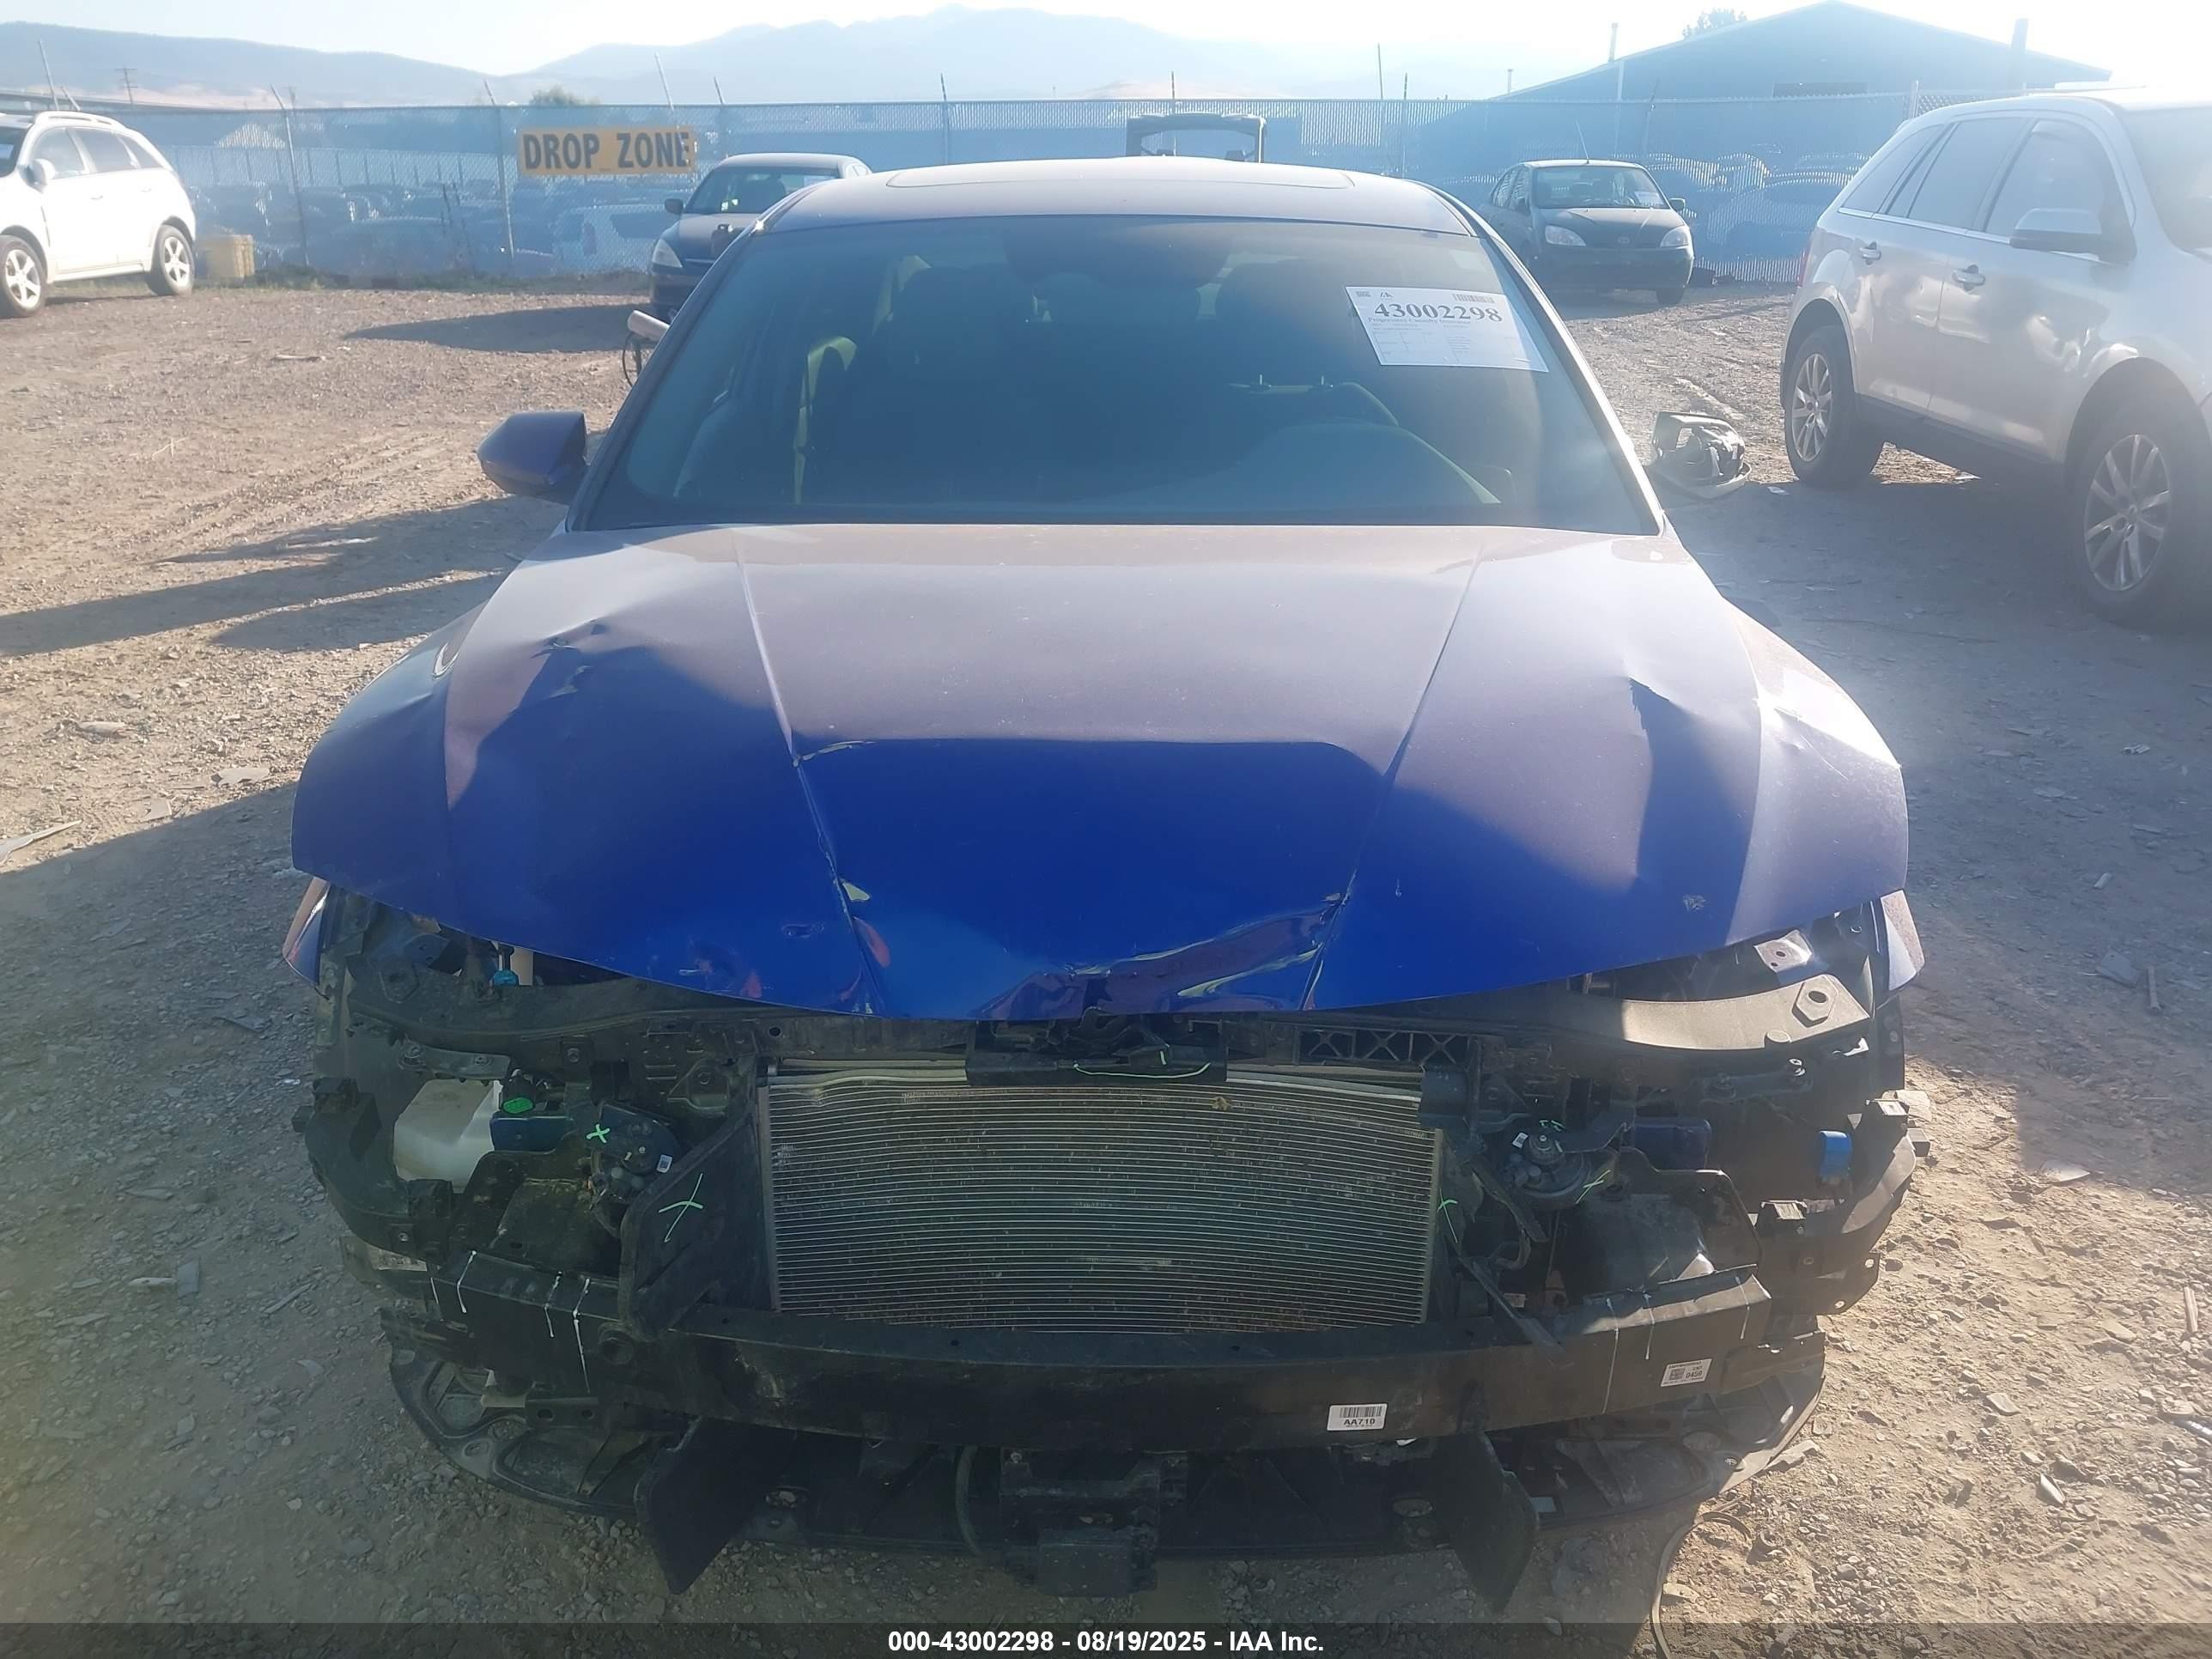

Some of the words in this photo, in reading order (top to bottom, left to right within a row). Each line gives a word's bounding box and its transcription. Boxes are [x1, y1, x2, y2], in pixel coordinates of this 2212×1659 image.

[523, 132, 600, 170] DROP
[617, 131, 691, 169] ZONE
[1374, 302, 1503, 322] 43002298
